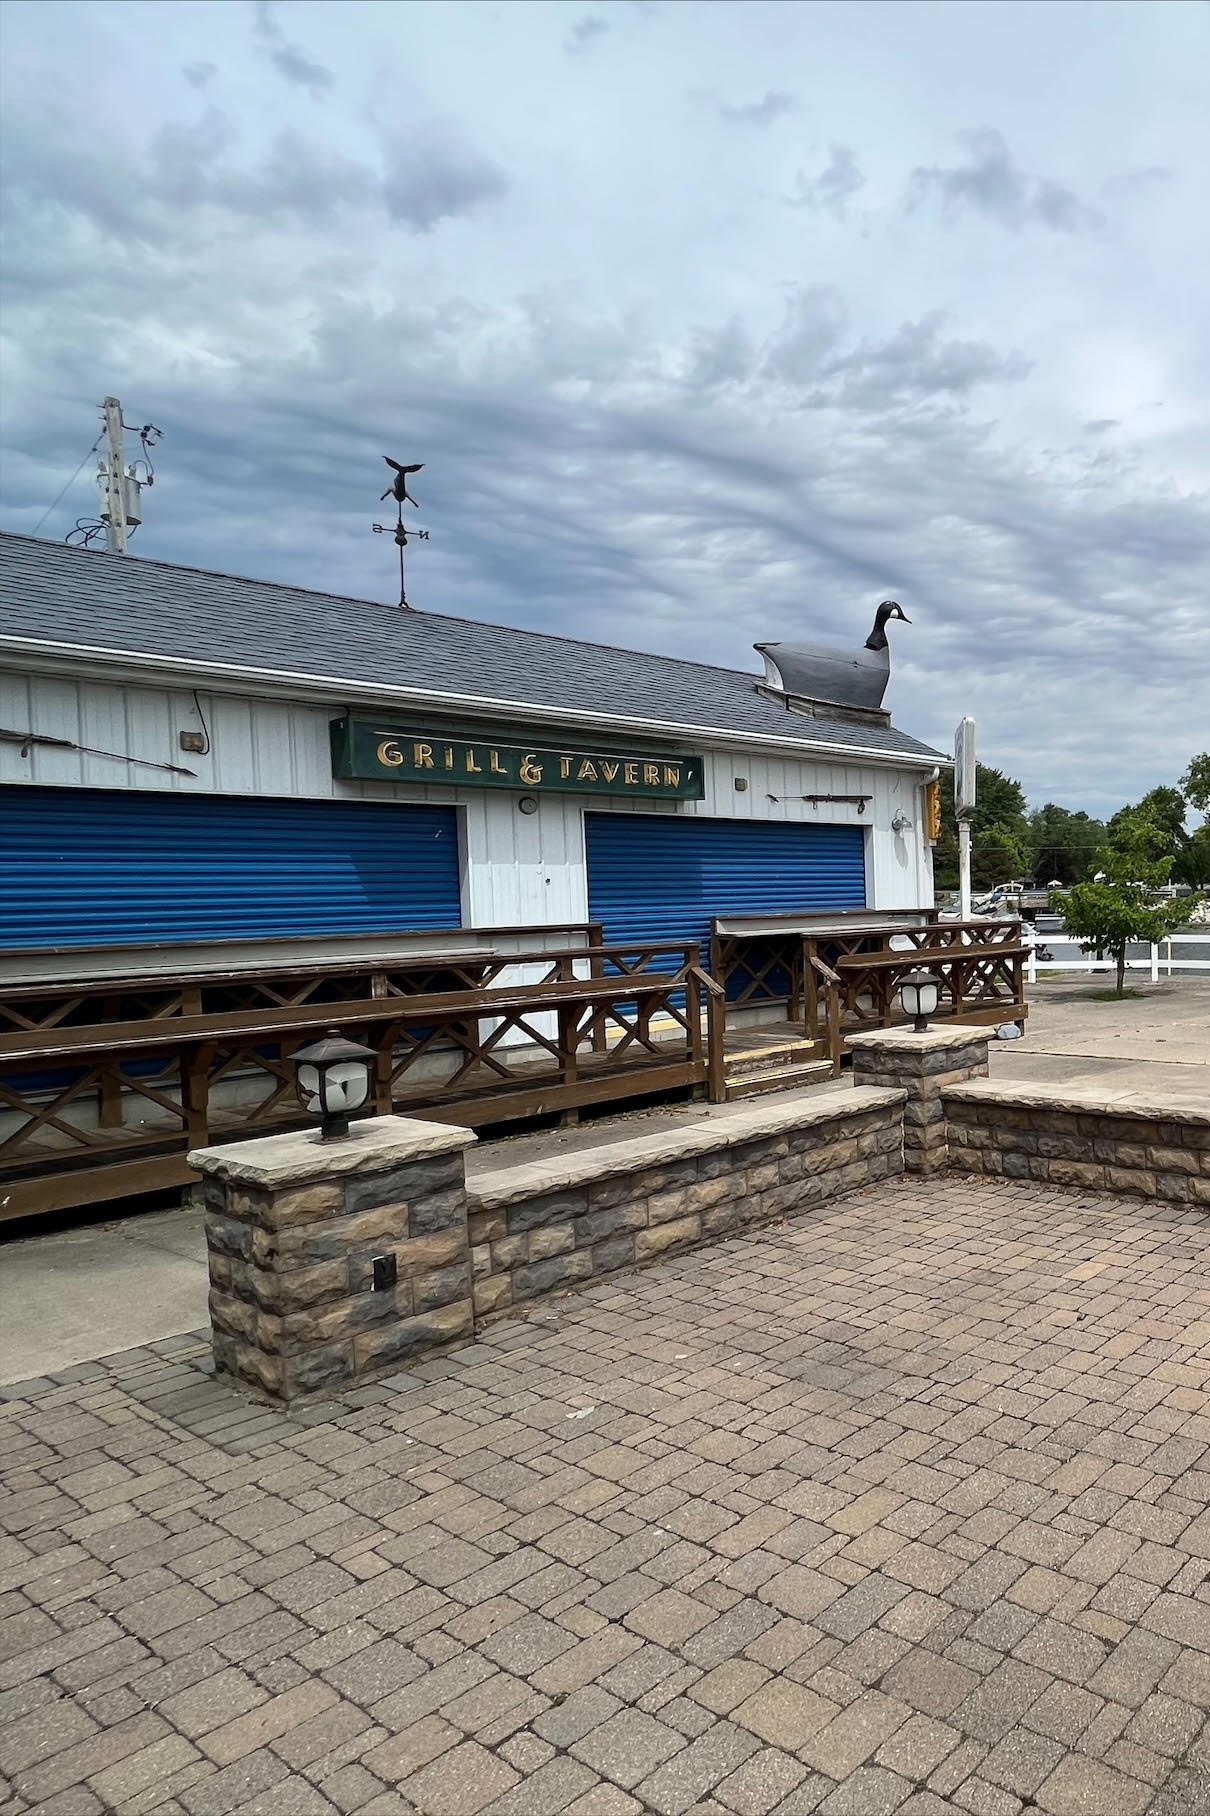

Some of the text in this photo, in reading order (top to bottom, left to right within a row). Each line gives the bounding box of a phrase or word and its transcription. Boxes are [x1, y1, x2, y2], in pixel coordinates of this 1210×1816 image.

[377, 740, 680, 788] GRILL & TAVERN
